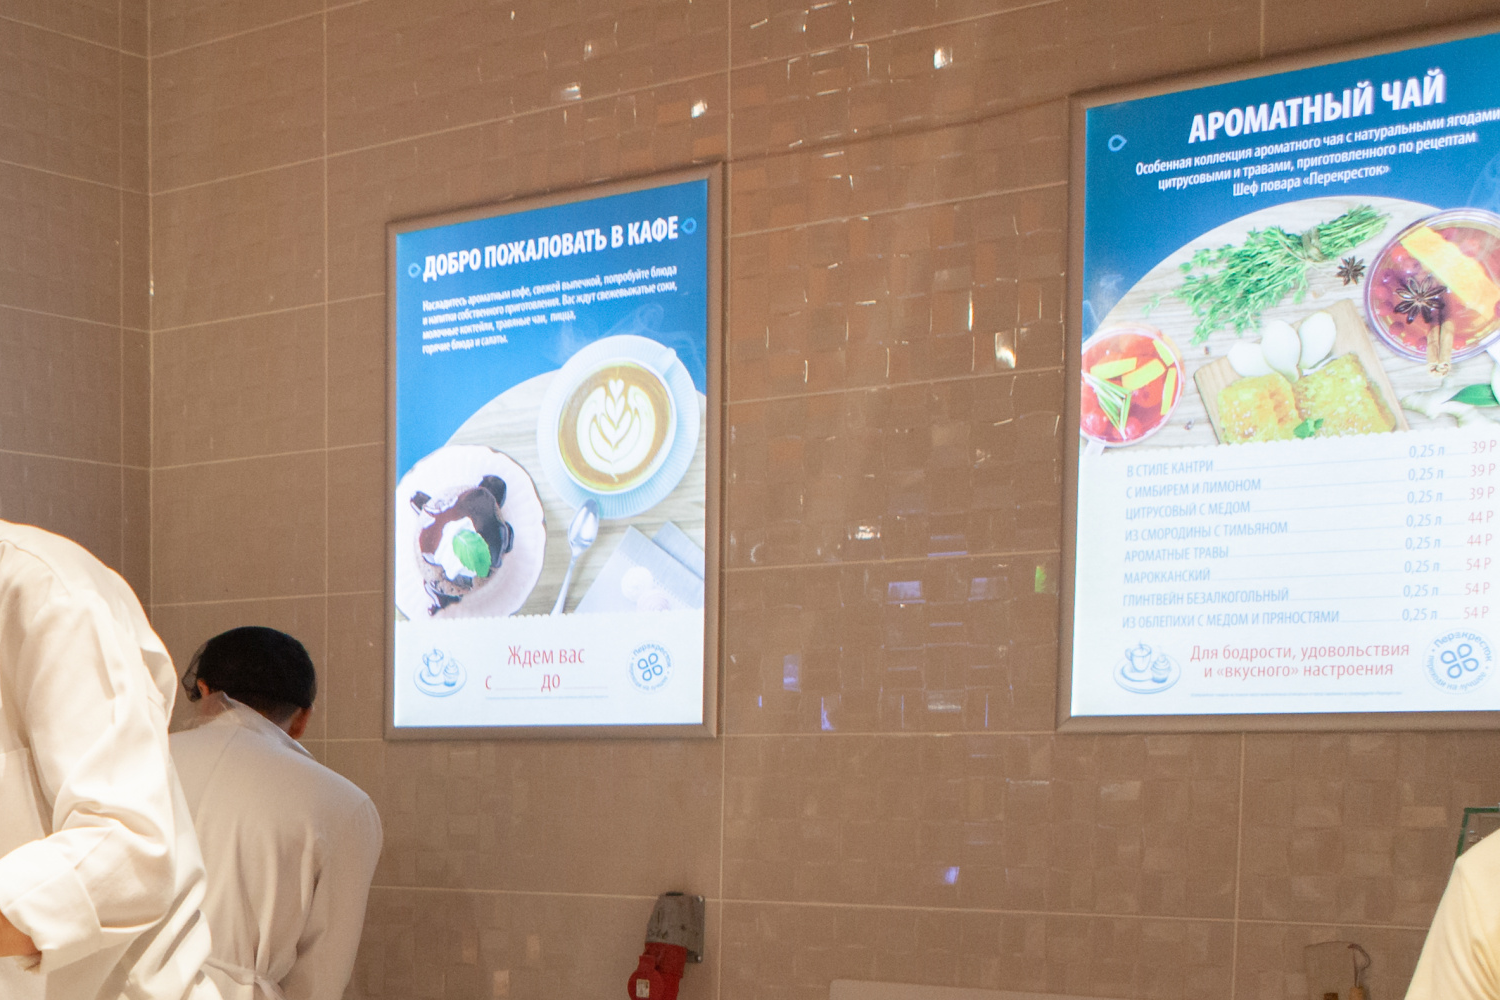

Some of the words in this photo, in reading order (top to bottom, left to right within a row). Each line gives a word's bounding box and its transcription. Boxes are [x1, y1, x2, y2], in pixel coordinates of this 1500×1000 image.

[1188, 81, 1374, 144] АРОМАТНЫЙ
[1381, 67, 1447, 110] ЧАЙ
[1136, 157, 1192, 176] Особенная
[1194, 148, 1251, 167] коллекция
[1254, 136, 1321, 159] ароматного
[1323, 133, 1343, 146] чая
[1346, 132, 1352, 143] с
[1354, 117, 1444, 142] натуральными
[1447, 107, 1500, 127] ягодами
[1158, 169, 1231, 191] цитрусовыми
[1233, 168, 1241, 178] и
[1243, 160, 1294, 178] травами,
[1297, 143, 1395, 171] приготовленного
[1399, 141, 1413, 153] по
[1416, 132, 1477, 154] рецептам
[1233, 182, 1259, 197] Шеф
[1260, 177, 1300, 192] повара
[1303, 164, 1390, 187] «Перекресток»
[422, 248, 482, 282] ДОБРО
[484, 228, 607, 269] ПОЖАЛОВАТЬ
[611, 224, 623, 248] В
[627, 215, 679, 246] КАФЕ
[1409, 444, 1434, 458] 0,25
[1437, 446, 1445, 456] л
[1471, 441, 1486, 454] 39
[1490, 440, 1497, 452] Р
[1127, 465, 1133, 477] В
[1136, 463, 1168, 477] СТИЛЕ
[1172, 460, 1213, 475] КАНТРИ
[1408, 468, 1433, 482] 0,25
[1436, 470, 1444, 479] л
[1471, 464, 1485, 477] 39
[1489, 463, 1495, 476] Р
[1126, 487, 1132, 499] С
[1135, 483, 1189, 498] ИМБИРЕМ
[1192, 483, 1199, 494] И
[1202, 478, 1261, 494] ЛИМОНОМ
[1469, 487, 1483, 500] 39
[1488, 486, 1494, 499] Р
[1407, 490, 1432, 505] 0,25
[1436, 493, 1443, 501] л
[1126, 503, 1196, 521] ЦИТРУСОВЫЙ
[1199, 504, 1205, 515] С
[1208, 501, 1250, 516] МЕДОМ
[1468, 512, 1482, 524] 44
[1486, 511, 1493, 523] Р
[1406, 514, 1431, 528] 0,25
[1435, 516, 1442, 525] л
[1125, 529, 1138, 542] ИЗ
[1141, 525, 1211, 541] СМОРОДИНЫ
[1214, 525, 1220, 537] С
[1224, 522, 1288, 536] ТИМЬЯНОМ
[1467, 535, 1481, 546] 44
[1485, 533, 1492, 546] Р
[1405, 537, 1430, 551] 0,25
[1434, 539, 1441, 548] л
[1125, 548, 1190, 562] АРОМАТНЫЕ
[1193, 546, 1229, 559] ТРАВЫ
[1404, 560, 1429, 574] 0,25
[1433, 562, 1440, 572] л
[1466, 558, 1480, 570] 54
[1484, 557, 1491, 570] Р
[1124, 568, 1210, 584] МАРОККАНСКИЙ
[1403, 585, 1428, 599] 0,25
[1432, 587, 1439, 596] л
[1465, 583, 1479, 595] 54
[1483, 582, 1490, 594] Р
[1123, 591, 1183, 606] ГЛИНТВЕЙН
[1187, 588, 1289, 604] БЕЗАЛКОГОЛЬНЫЙ
[1123, 617, 1135, 628] ИЗ
[1138, 615, 1195, 628] ОБЛЕПИХИ
[1198, 614, 1204, 626] С
[1207, 613, 1248, 627] МЕДОМ
[1252, 613, 1259, 624] И
[1263, 610, 1339, 624] ПРЯНОСТЯМИ
[1402, 608, 1427, 622] 0,25
[1430, 611, 1437, 620] л
[1464, 607, 1478, 619] 54
[1482, 606, 1489, 618] Р
[508, 645, 553, 668] Ждем
[559, 649, 585, 664] вас
[1190, 646, 1218, 662] Для
[1223, 645, 1296, 662] бодрости,
[1301, 645, 1409, 662] удовольствия
[1204, 667, 1212, 677] и
[1217, 665, 1299, 680] «вкусного»
[1304, 663, 1393, 679] настроения
[485, 675, 492, 690] с
[541, 674, 560, 692] до
